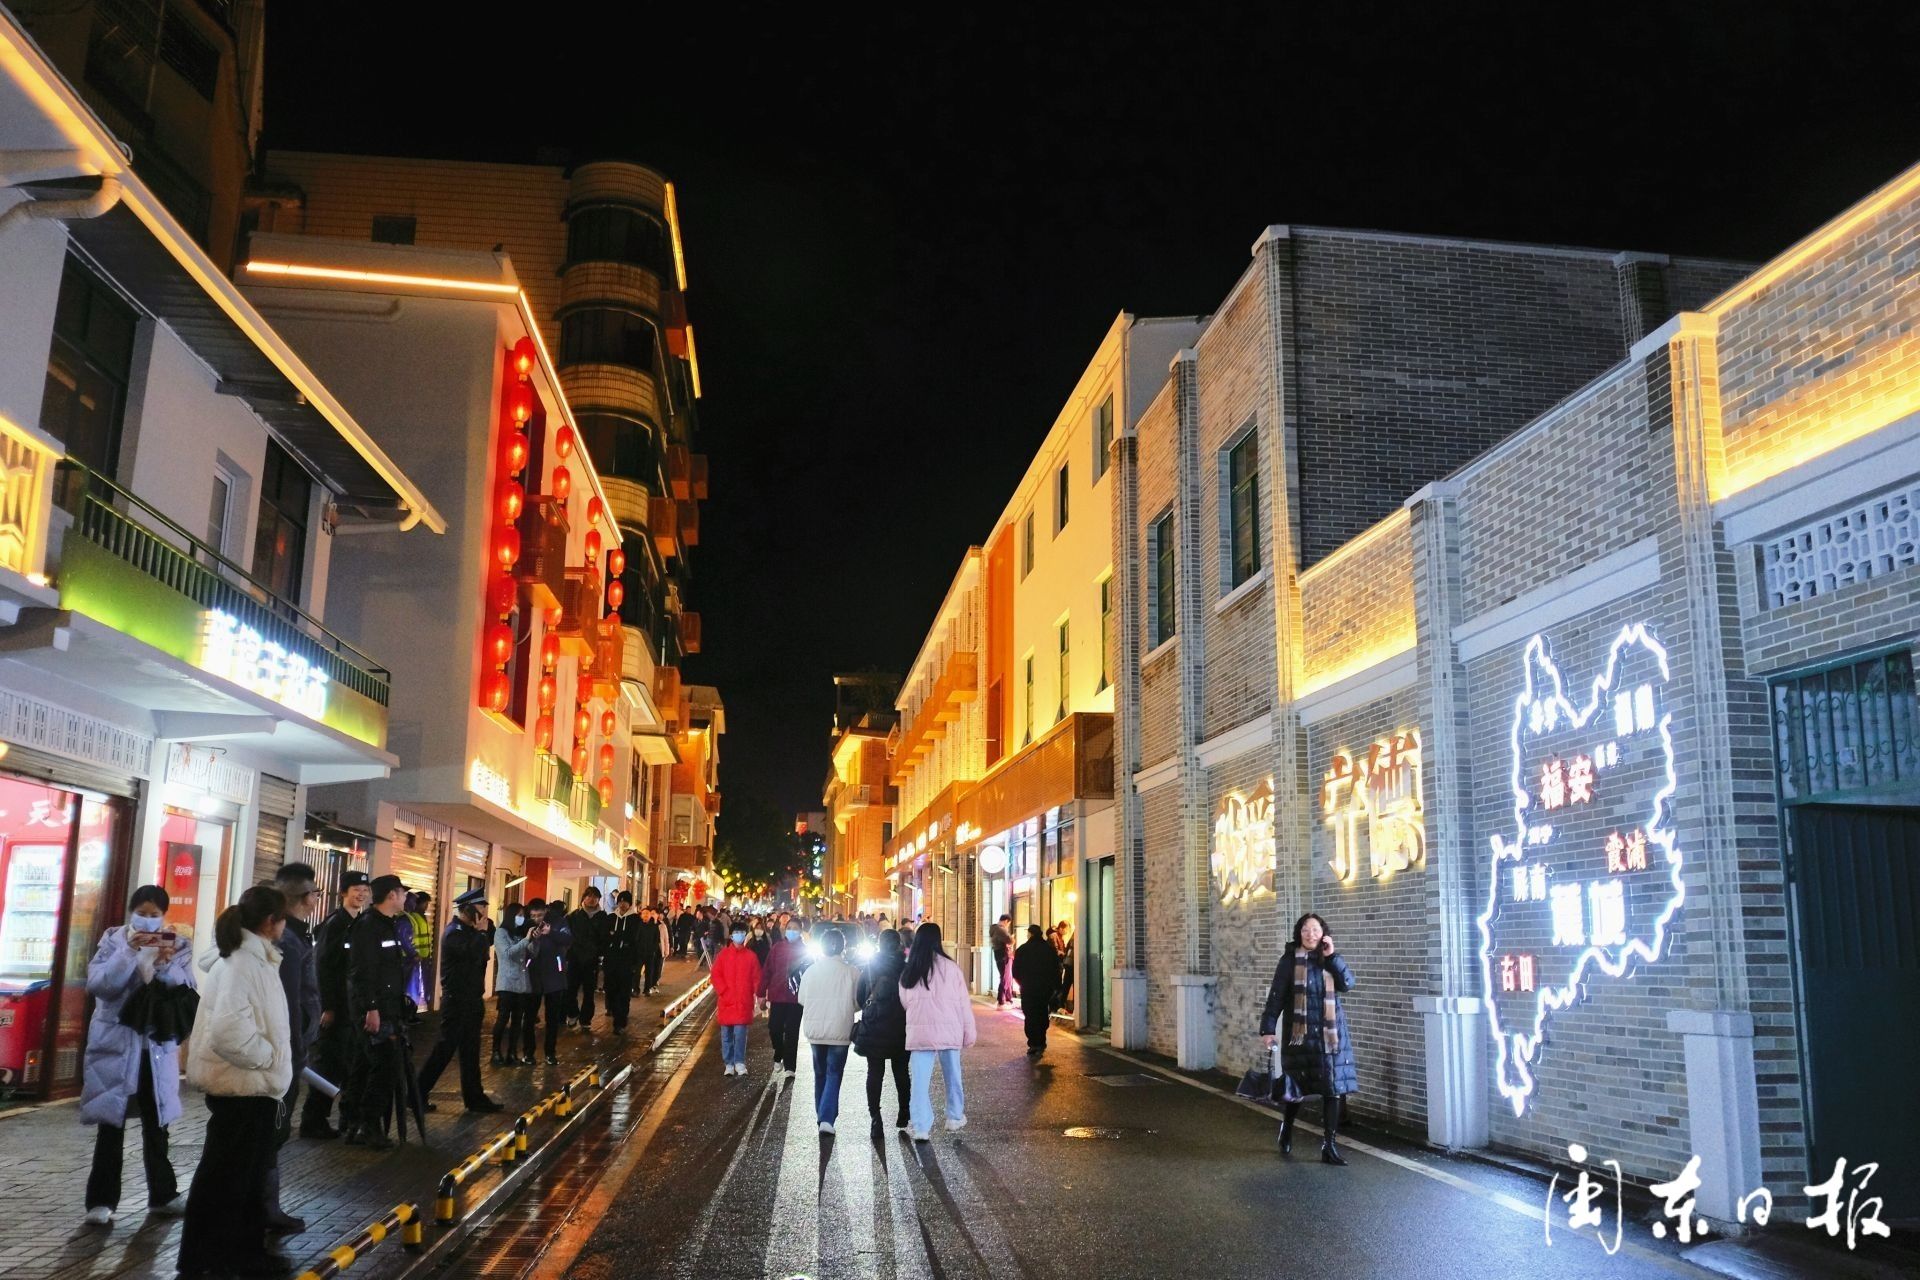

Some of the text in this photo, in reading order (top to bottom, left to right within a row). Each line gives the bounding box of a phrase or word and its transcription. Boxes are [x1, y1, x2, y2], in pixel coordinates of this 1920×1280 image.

[1317, 731, 1424, 882] 宁德
[1540, 755, 1594, 810] 福安
[1605, 829, 1647, 874] 霞浦
[1501, 956, 1535, 992] 古田
